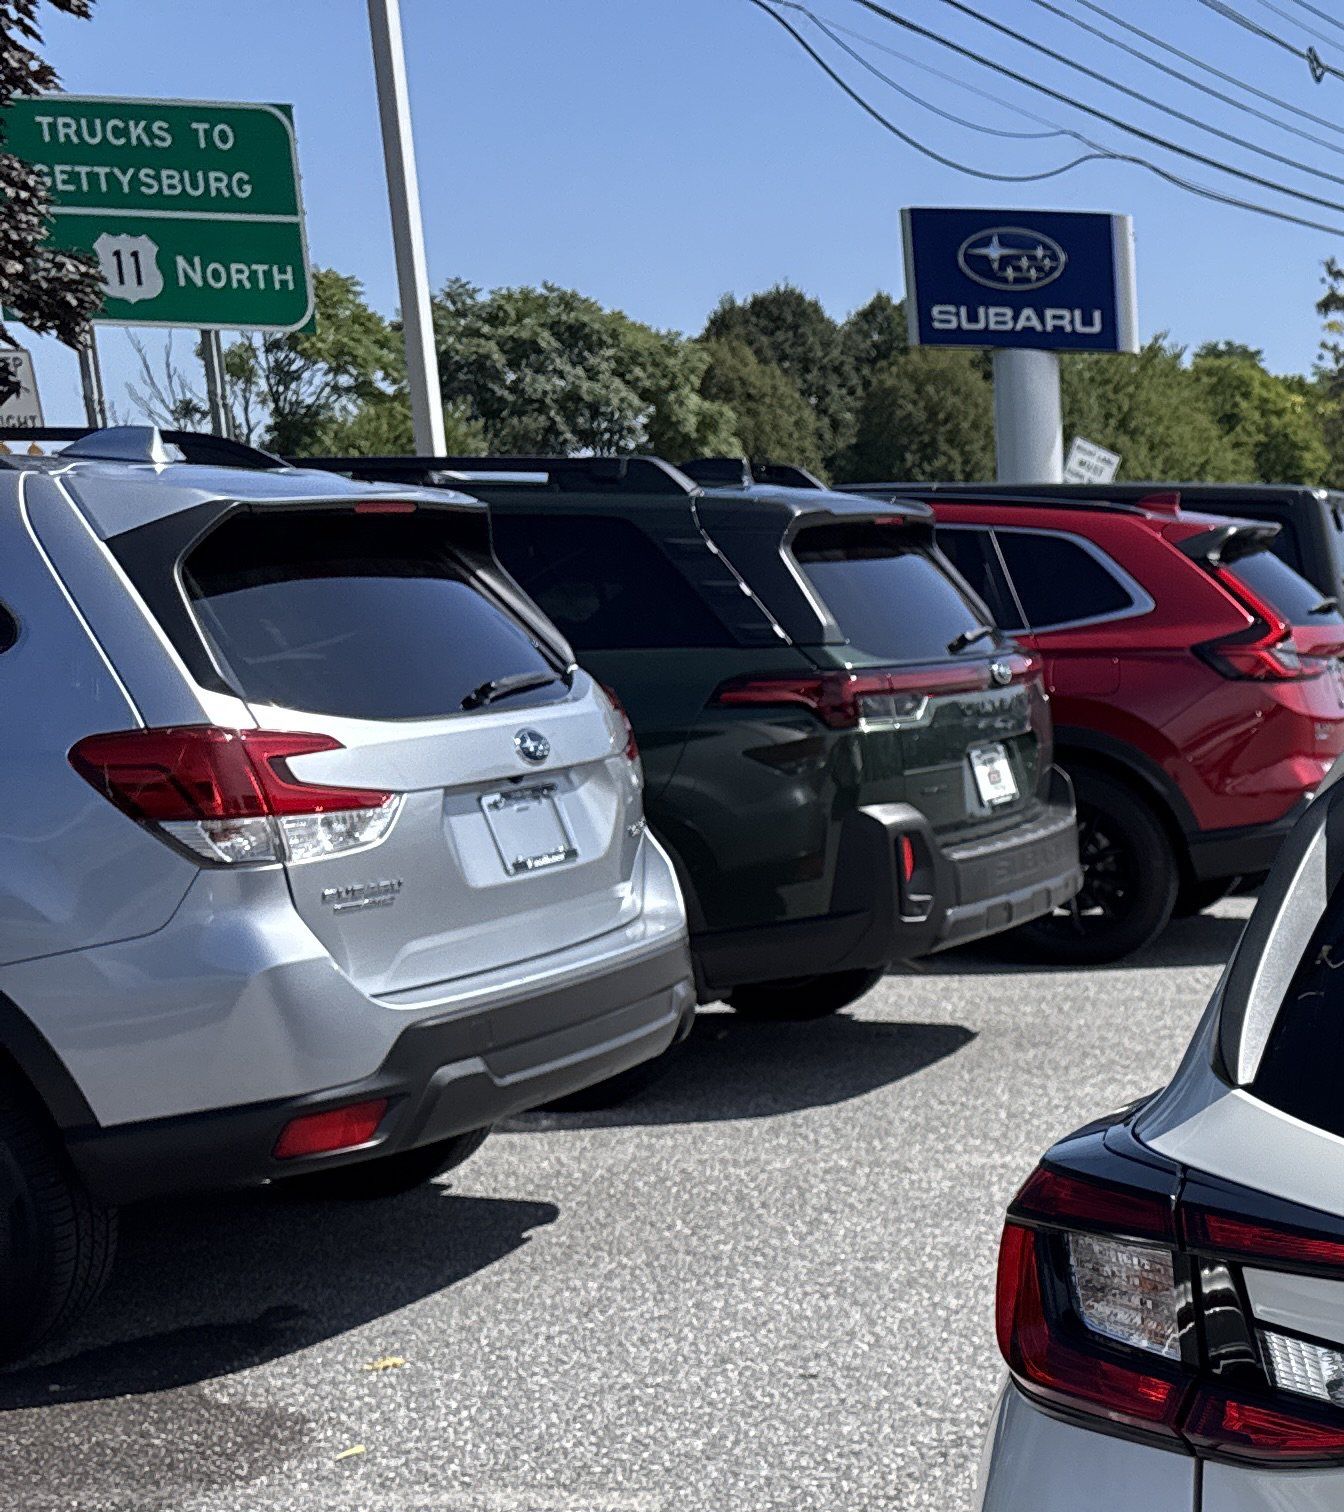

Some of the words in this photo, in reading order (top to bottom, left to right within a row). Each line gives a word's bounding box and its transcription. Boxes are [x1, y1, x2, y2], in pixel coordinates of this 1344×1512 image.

[35, 115, 173, 148] TRUCKS
[190, 121, 235, 151] TO
[112, 248, 144, 287] 11
[931, 303, 1102, 334] SUBARU
